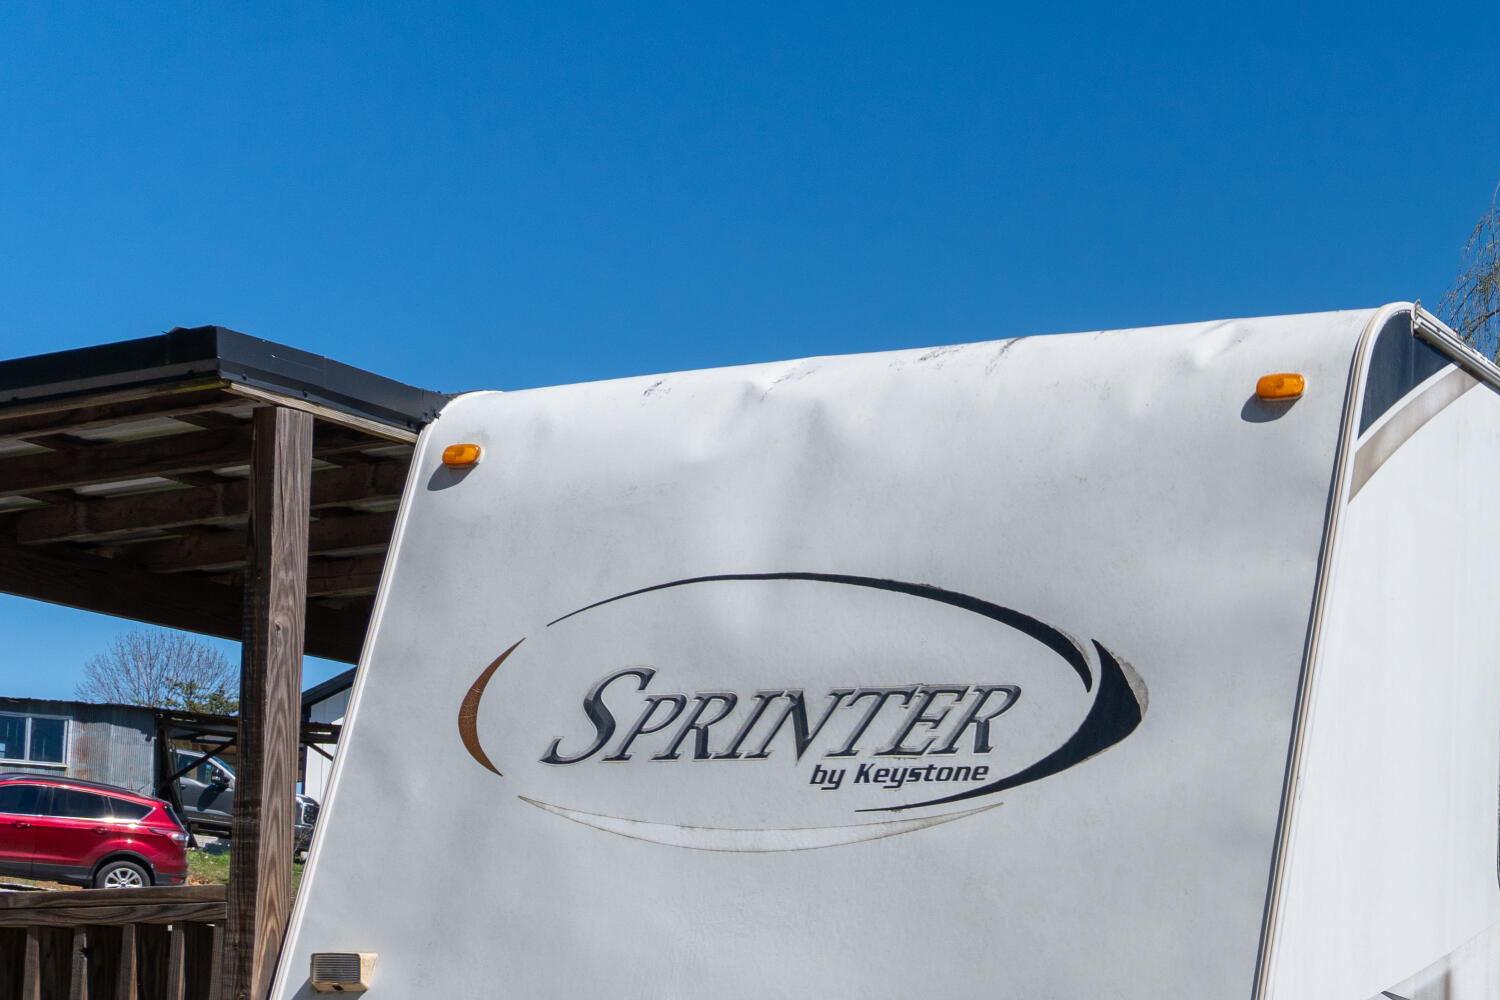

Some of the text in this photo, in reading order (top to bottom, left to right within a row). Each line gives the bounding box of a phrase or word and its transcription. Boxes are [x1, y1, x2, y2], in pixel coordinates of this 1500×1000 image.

[539, 666, 1022, 766] SPRINTER
[809, 763, 989, 790] by Keystone
